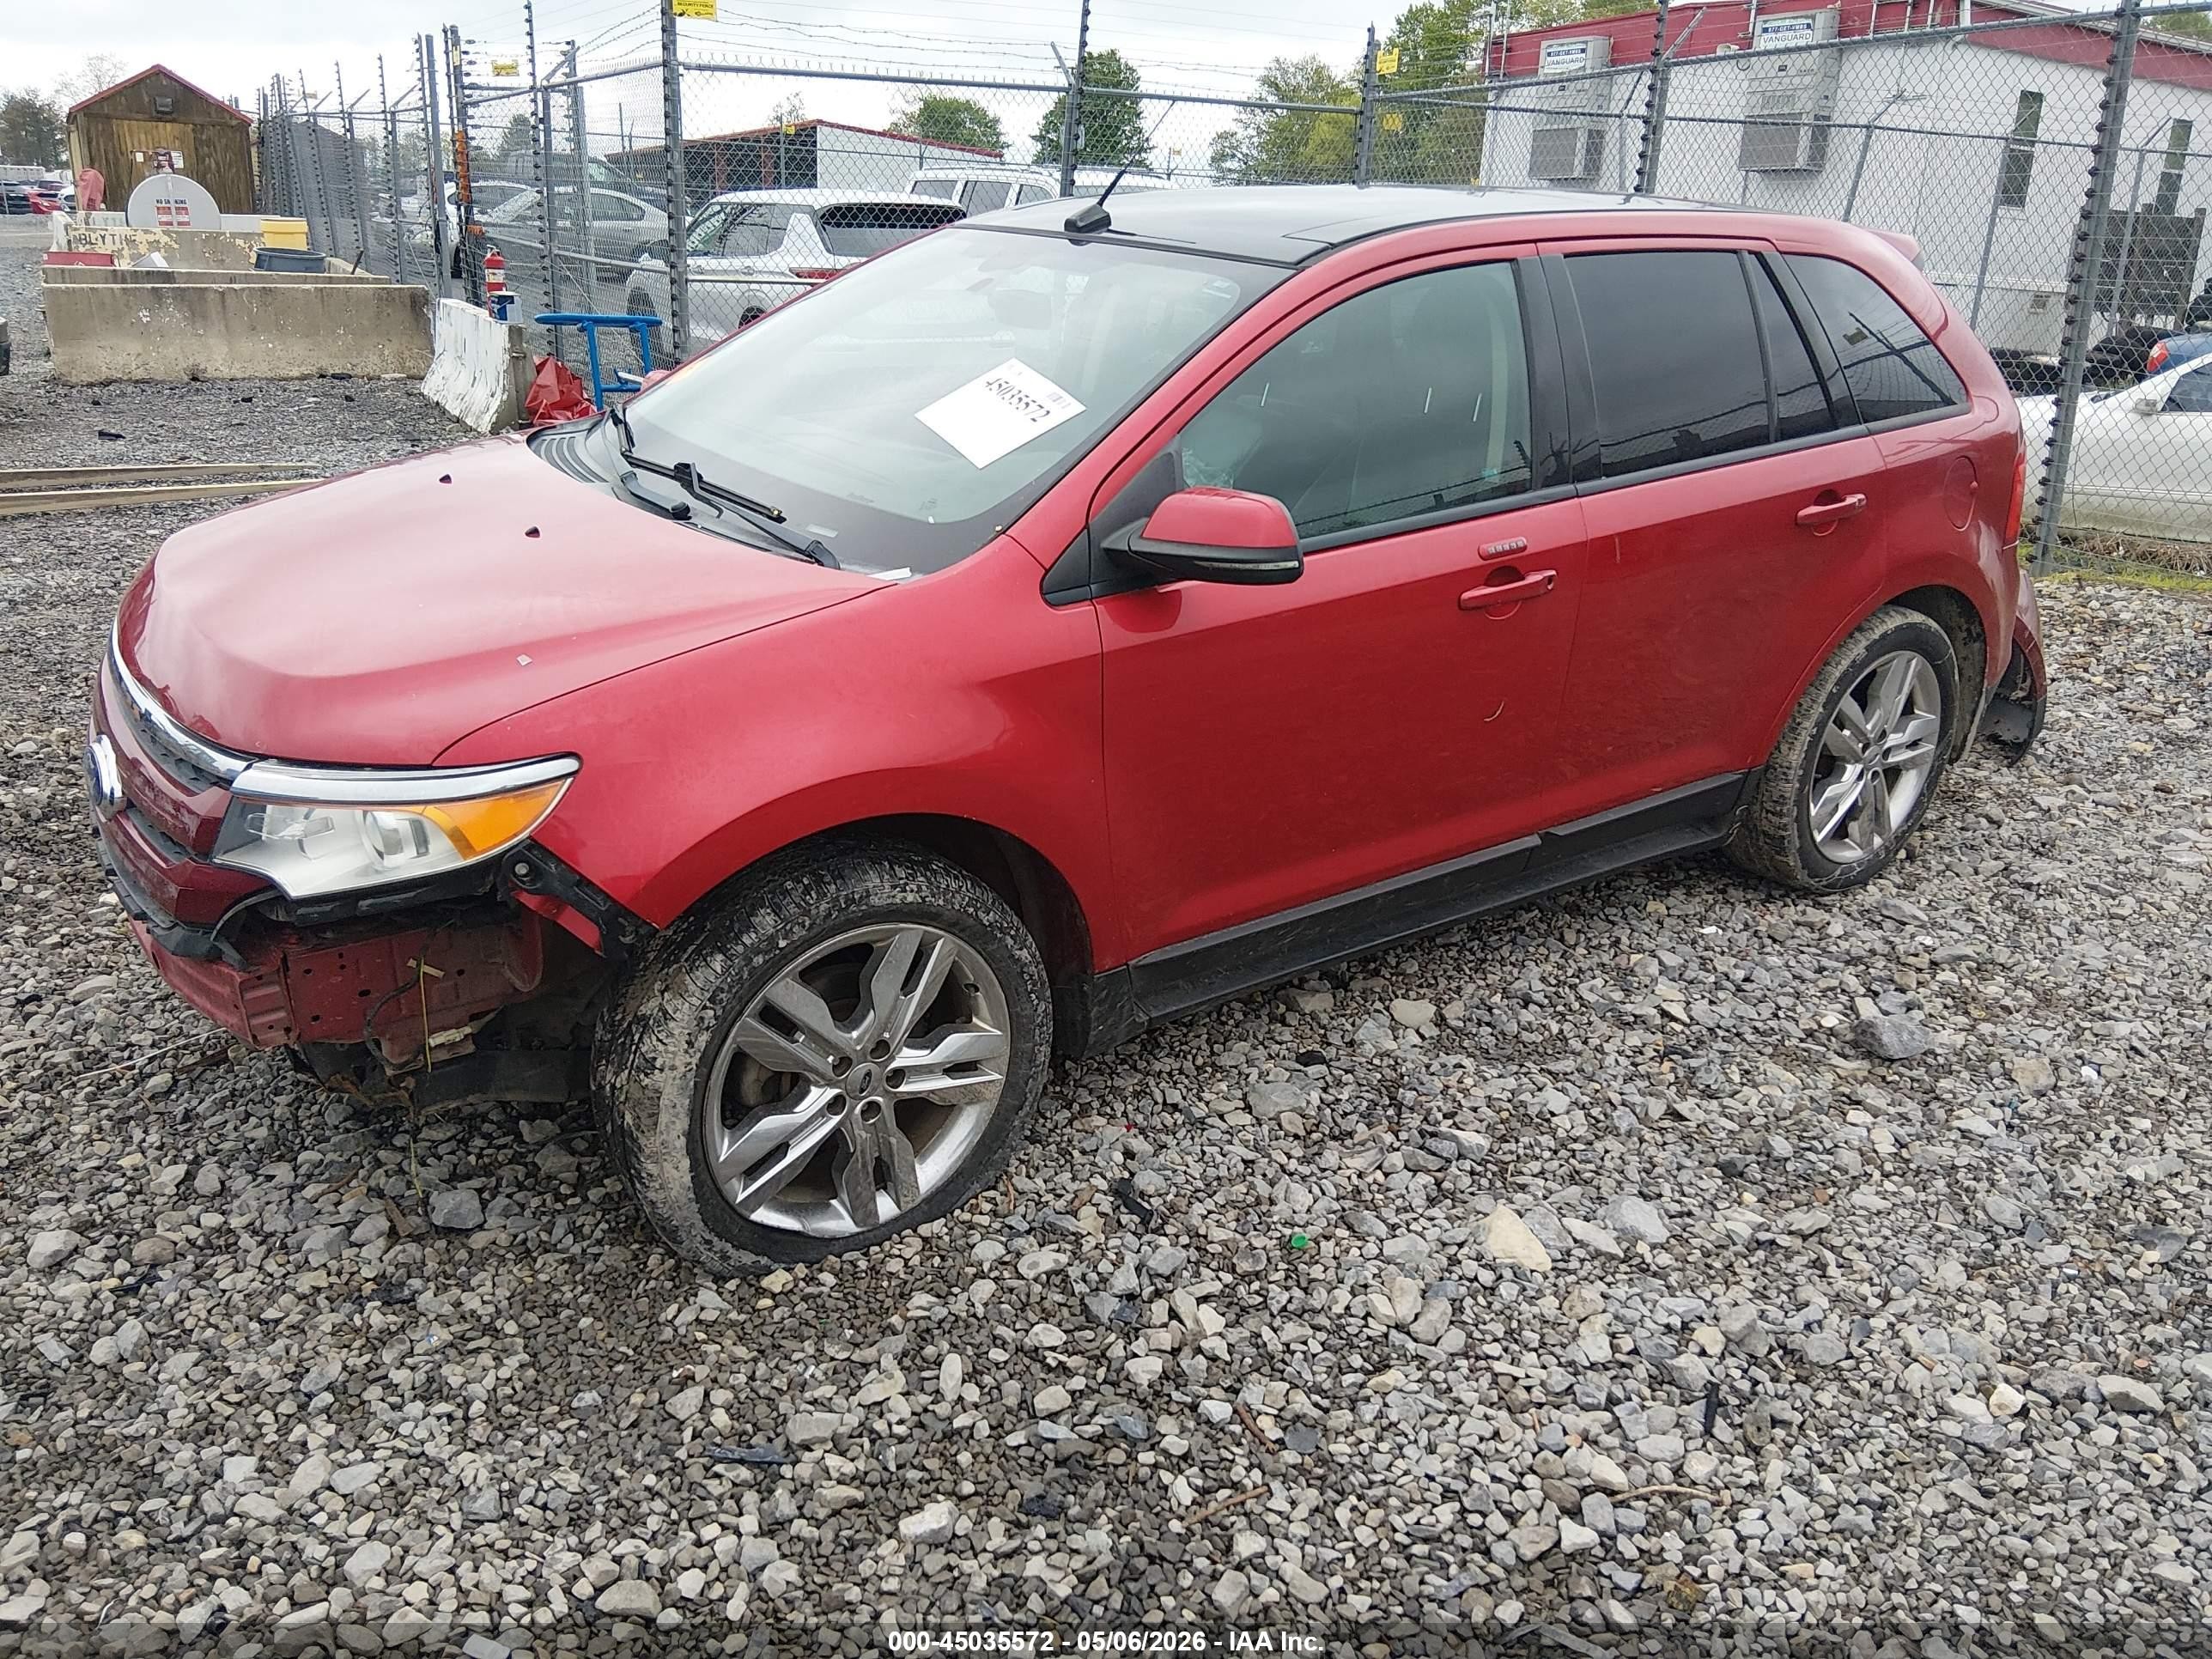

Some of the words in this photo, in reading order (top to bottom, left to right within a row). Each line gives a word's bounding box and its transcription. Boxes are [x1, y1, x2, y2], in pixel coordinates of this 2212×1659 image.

[1763, 33, 1811, 44] VANGUARD
[1547, 57, 1584, 65] VANGUARD
[985, 378, 1051, 422] 45035572
